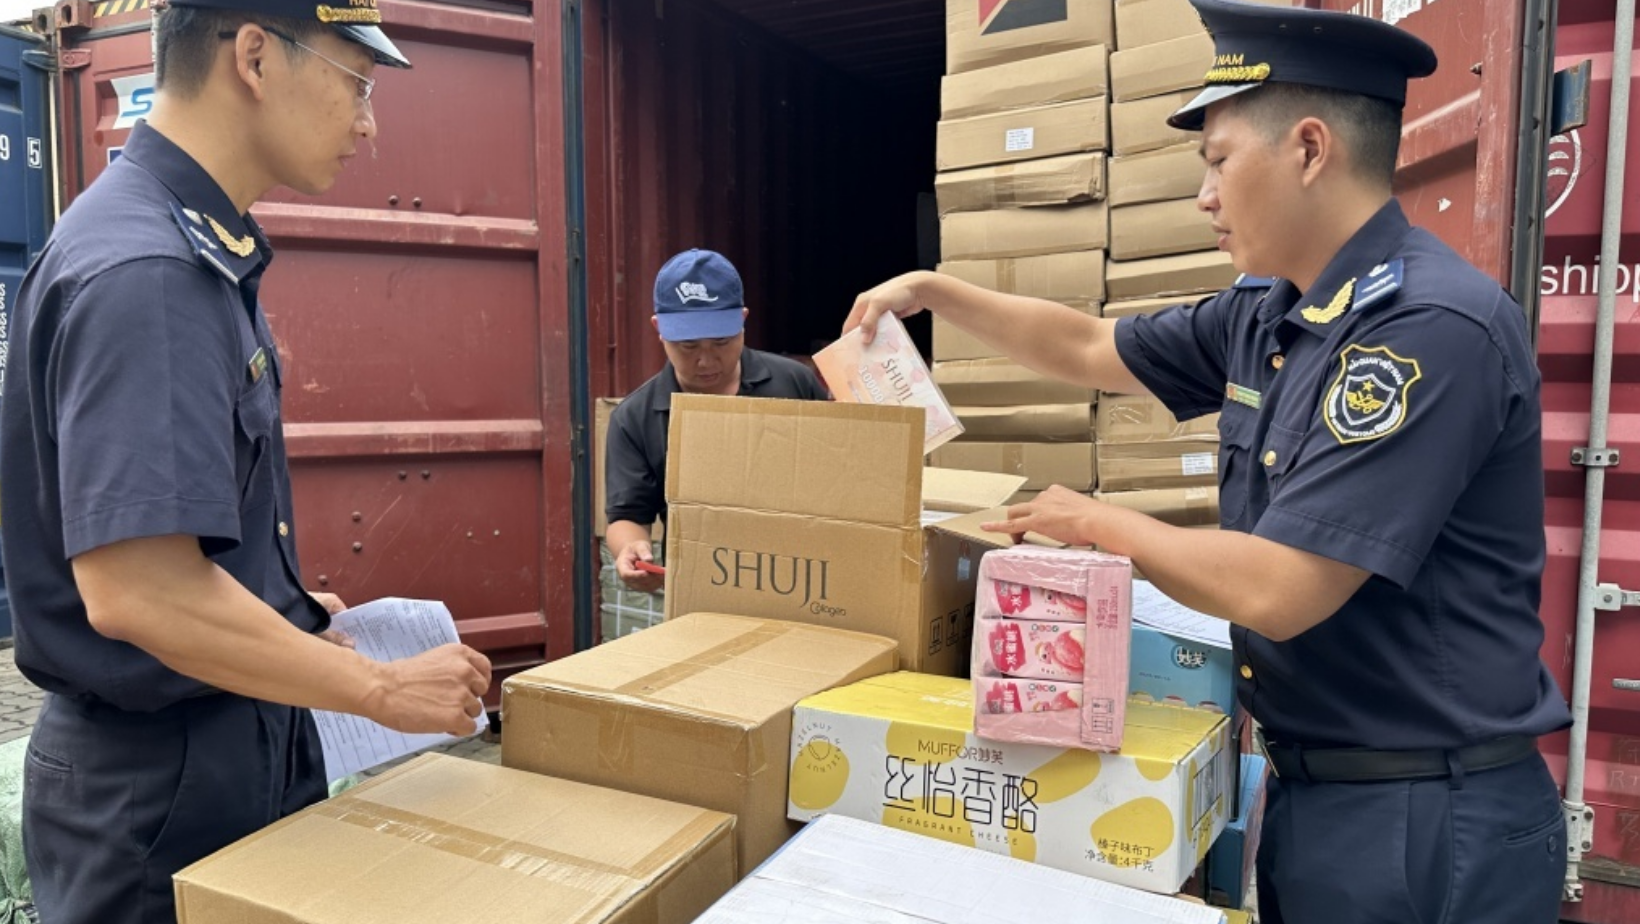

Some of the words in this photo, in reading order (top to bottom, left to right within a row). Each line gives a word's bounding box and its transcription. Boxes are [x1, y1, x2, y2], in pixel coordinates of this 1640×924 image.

[30, 140, 40, 166] 5
[881, 358, 913, 402] SHUJI
[711, 547, 829, 608] SHUJI
[882, 755, 1039, 834] 丝怡香酪
[899, 816, 963, 834] FRAGRANT
[969, 829, 1018, 846] CHEESE
